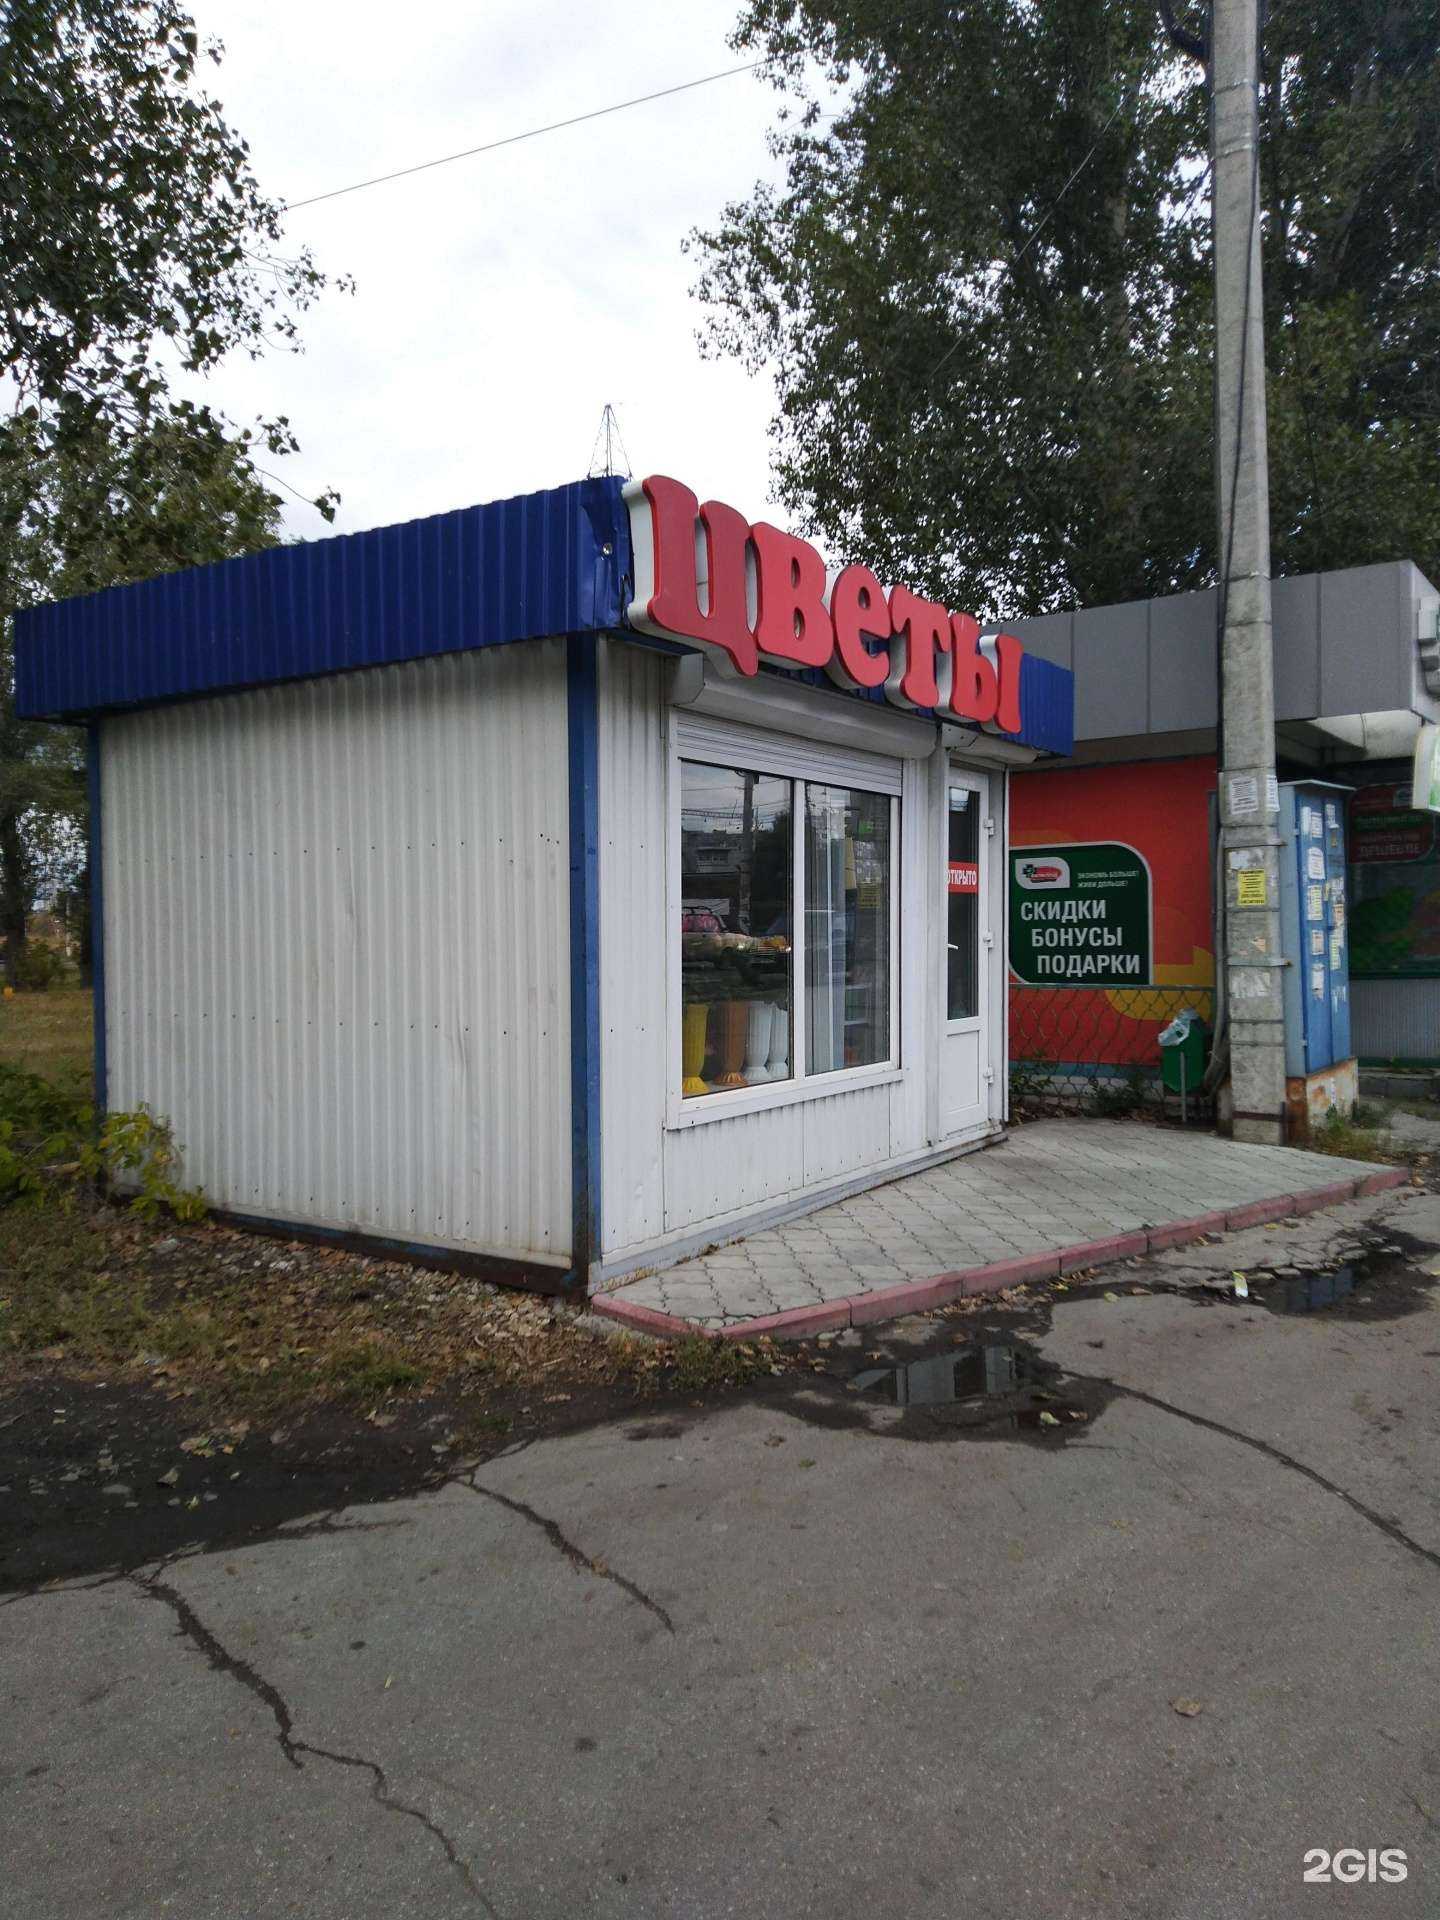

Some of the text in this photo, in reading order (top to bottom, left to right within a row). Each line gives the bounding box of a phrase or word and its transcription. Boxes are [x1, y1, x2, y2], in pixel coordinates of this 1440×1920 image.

[1020, 899, 1106, 924] СКИДКИ
[1031, 926, 1123, 947] БОНУСЫ
[1037, 954, 1140, 978] ПОДАРКИ
